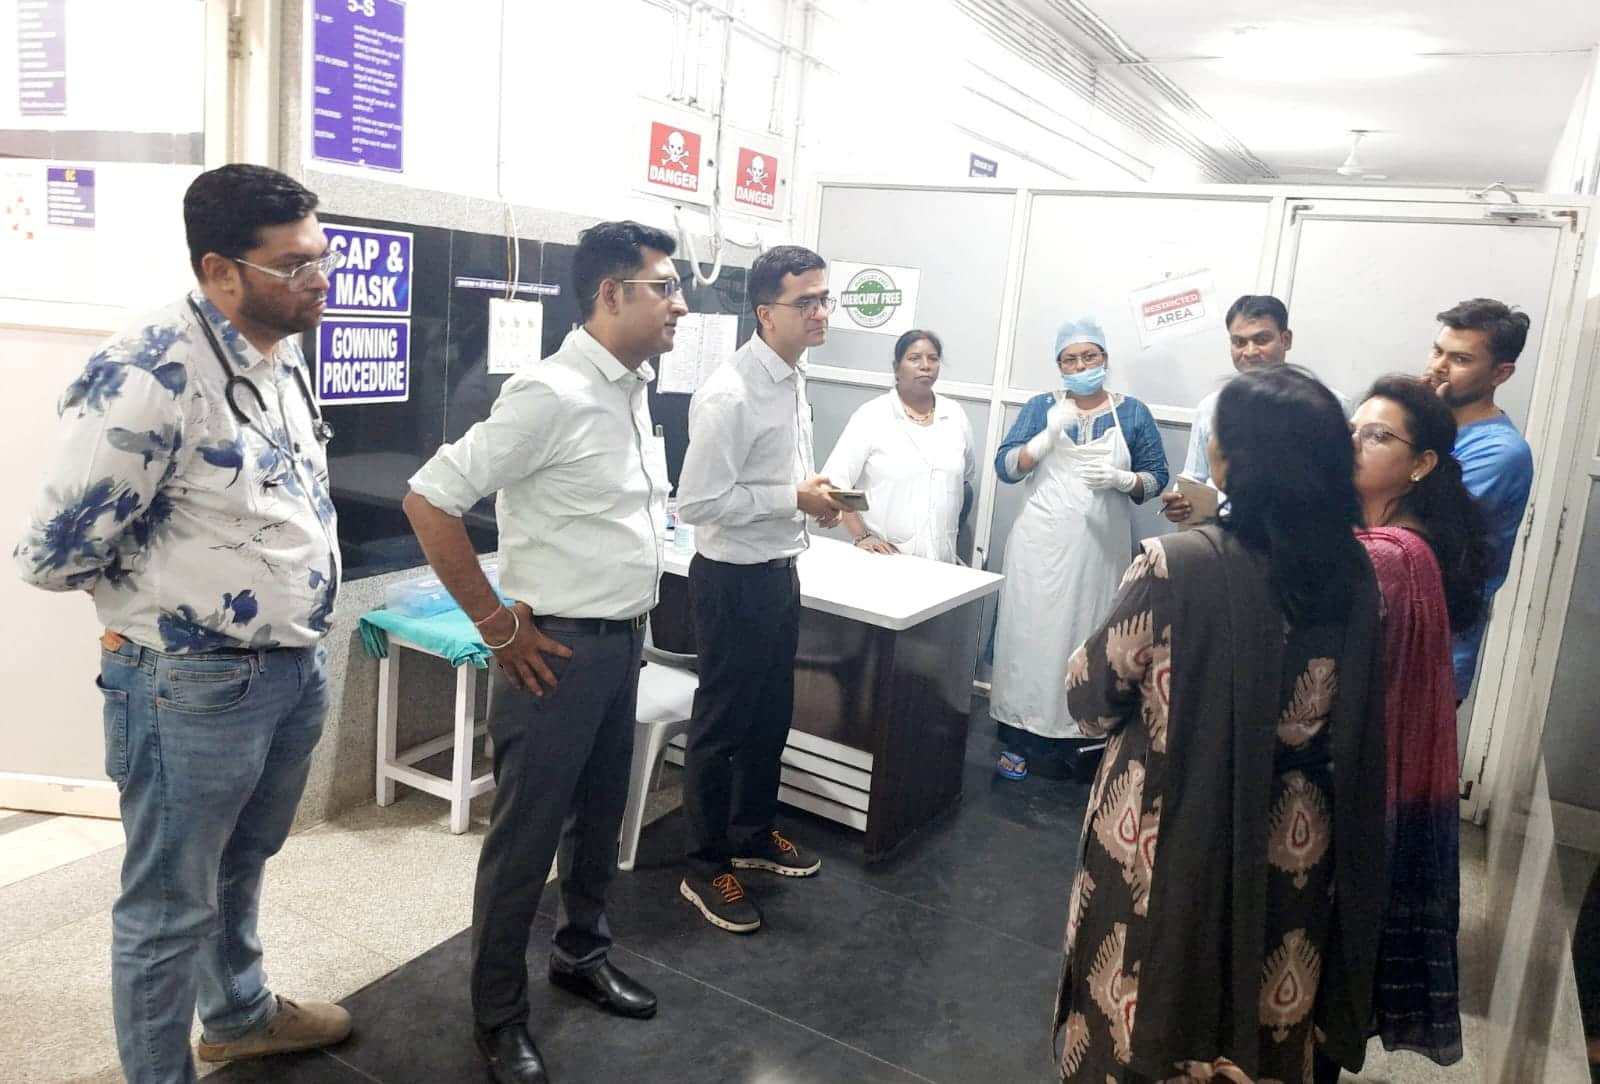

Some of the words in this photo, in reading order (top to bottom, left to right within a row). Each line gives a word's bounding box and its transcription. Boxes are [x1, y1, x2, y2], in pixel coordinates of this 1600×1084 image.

[649, 165, 698, 190] DANGER
[736, 186, 775, 208] DANGER
[330, 235, 380, 271] CAP
[386, 241, 404, 273] &
[335, 273, 398, 307] MASK
[841, 293, 879, 306] MERCURY
[881, 291, 901, 305] FREE
[1156, 308, 1194, 326] AREA
[332, 327, 398, 360] GOWNING
[323, 361, 405, 394] PROCEDURE
